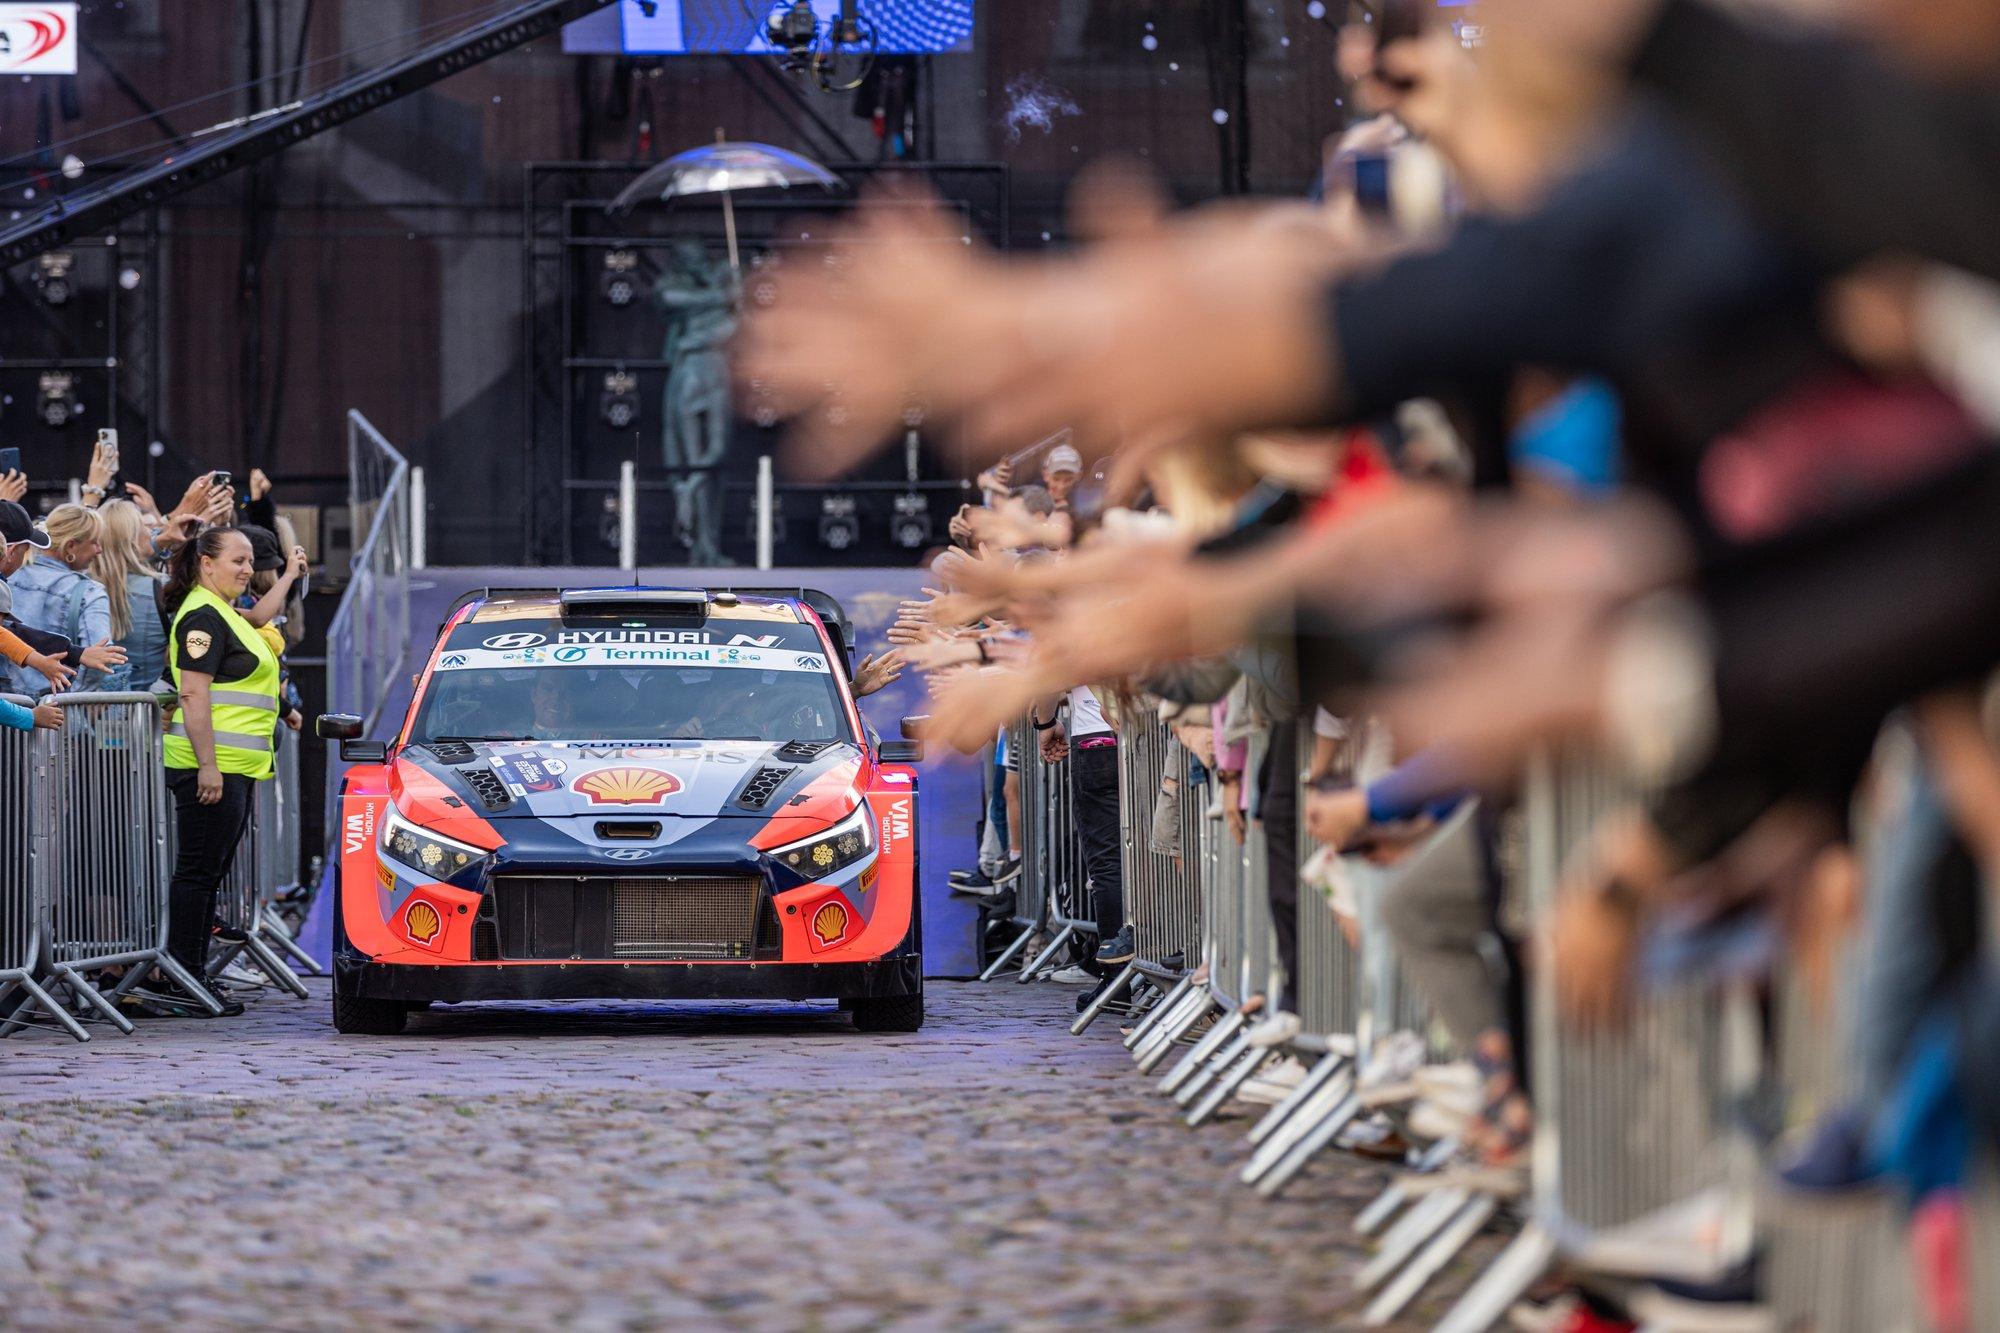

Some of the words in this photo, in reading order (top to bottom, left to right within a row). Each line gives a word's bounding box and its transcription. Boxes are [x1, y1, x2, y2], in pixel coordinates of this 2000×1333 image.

[558, 631, 710, 644] HYUNDAI
[602, 648, 710, 661] Terminal
[578, 747, 747, 764] MOBIS
[346, 814, 367, 854] WIA
[365, 803, 374, 836] HYUNDAI
[882, 817, 891, 854] HYUNDAI
[888, 799, 909, 840] WIA
